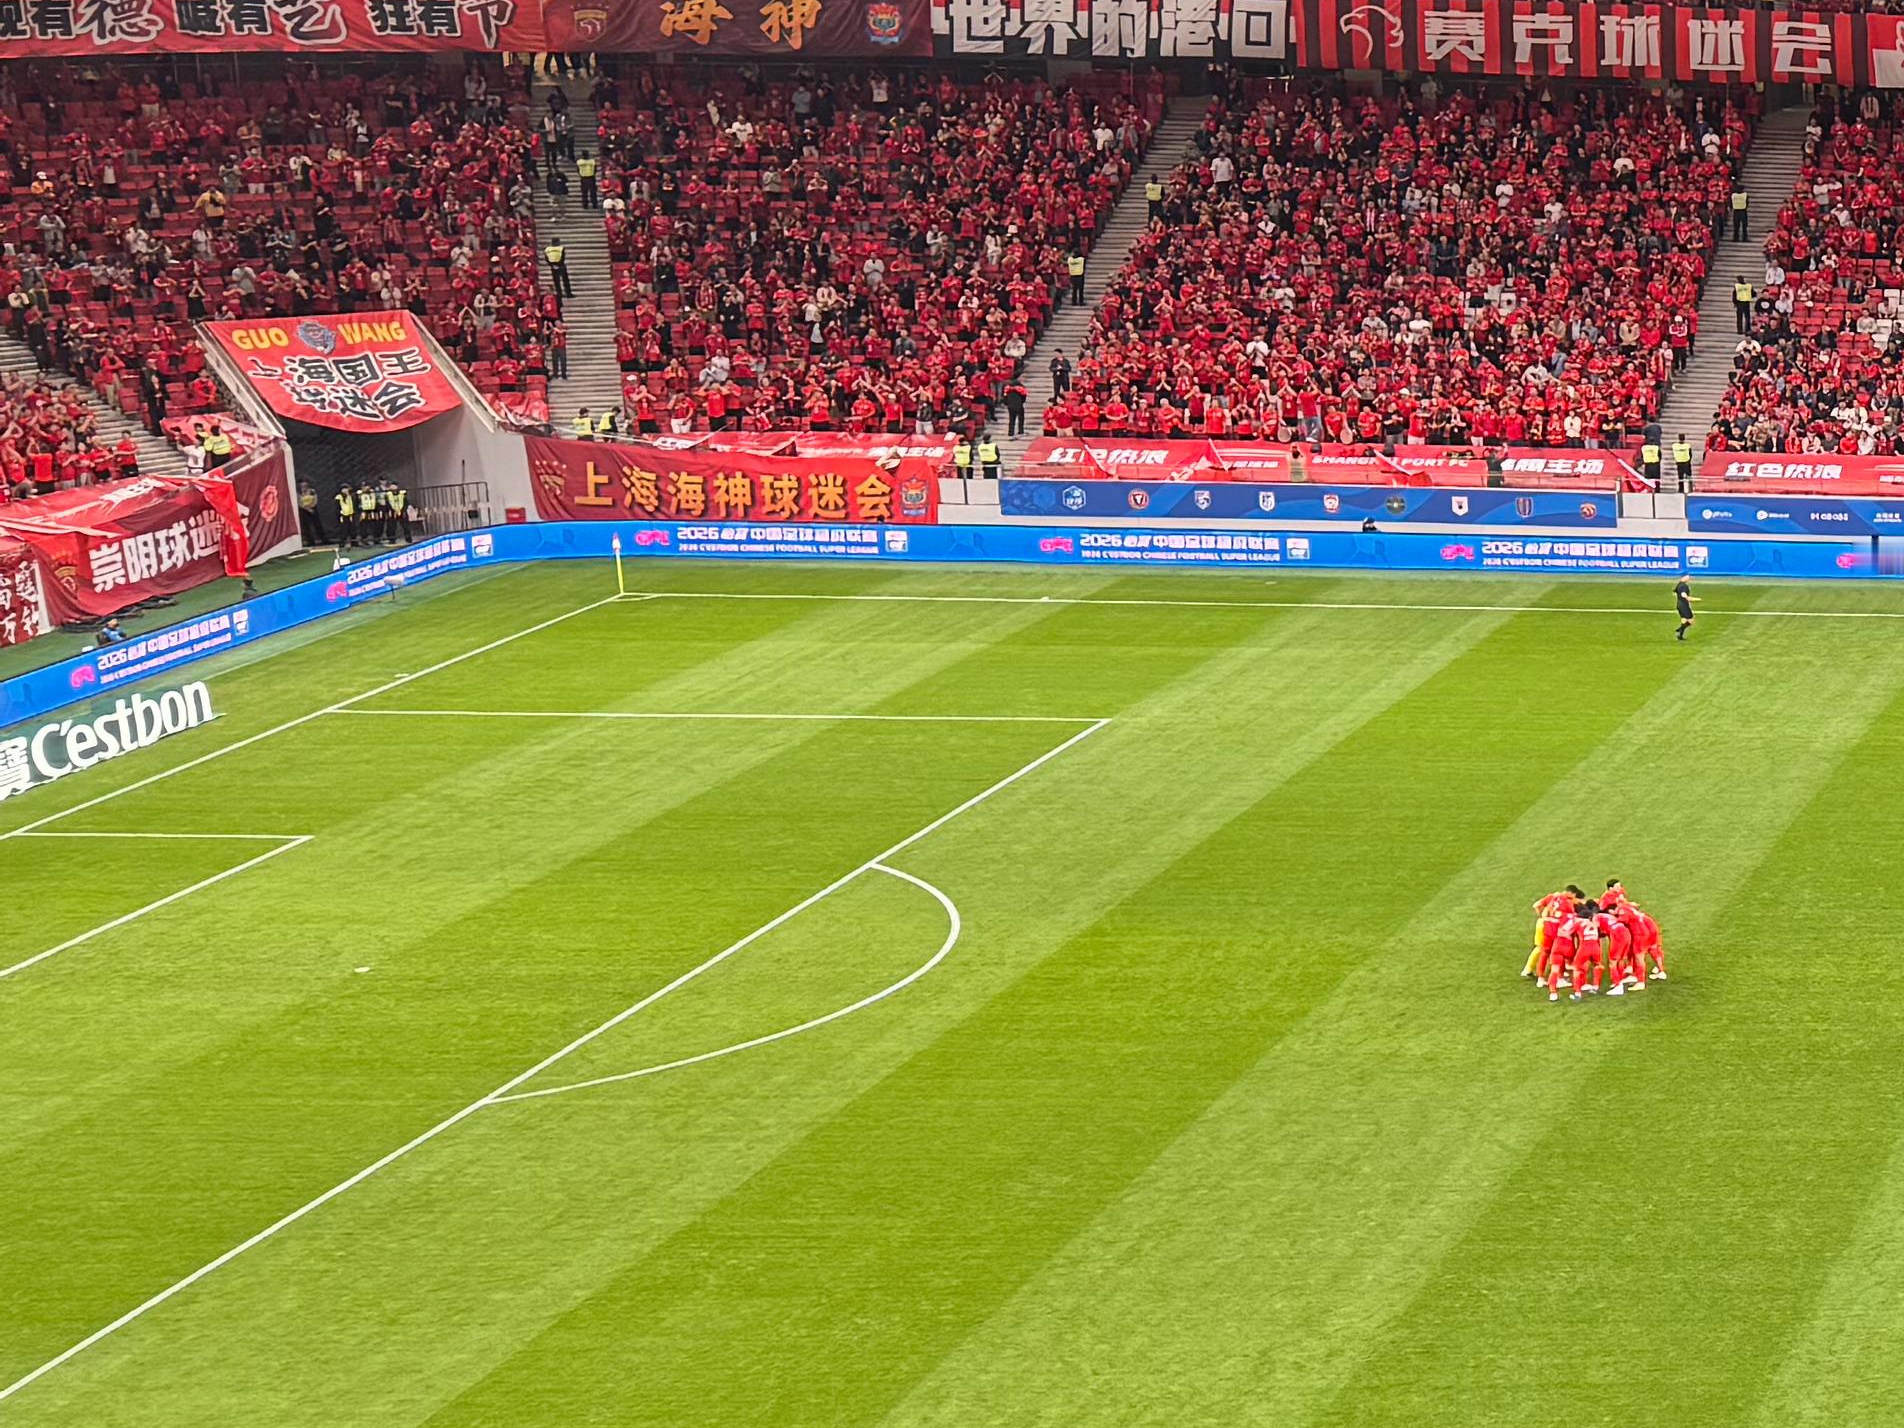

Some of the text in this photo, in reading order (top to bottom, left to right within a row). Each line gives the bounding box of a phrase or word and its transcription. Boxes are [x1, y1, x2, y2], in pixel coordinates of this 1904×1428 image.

[1424, 9, 1833, 75] 赛克球迷会
[231, 321, 406, 350] GUO WANG
[574, 460, 894, 520] 上海海神球迷会
[89, 501, 250, 593] 崇明球迷
[31, 680, 213, 778] C'estbon
